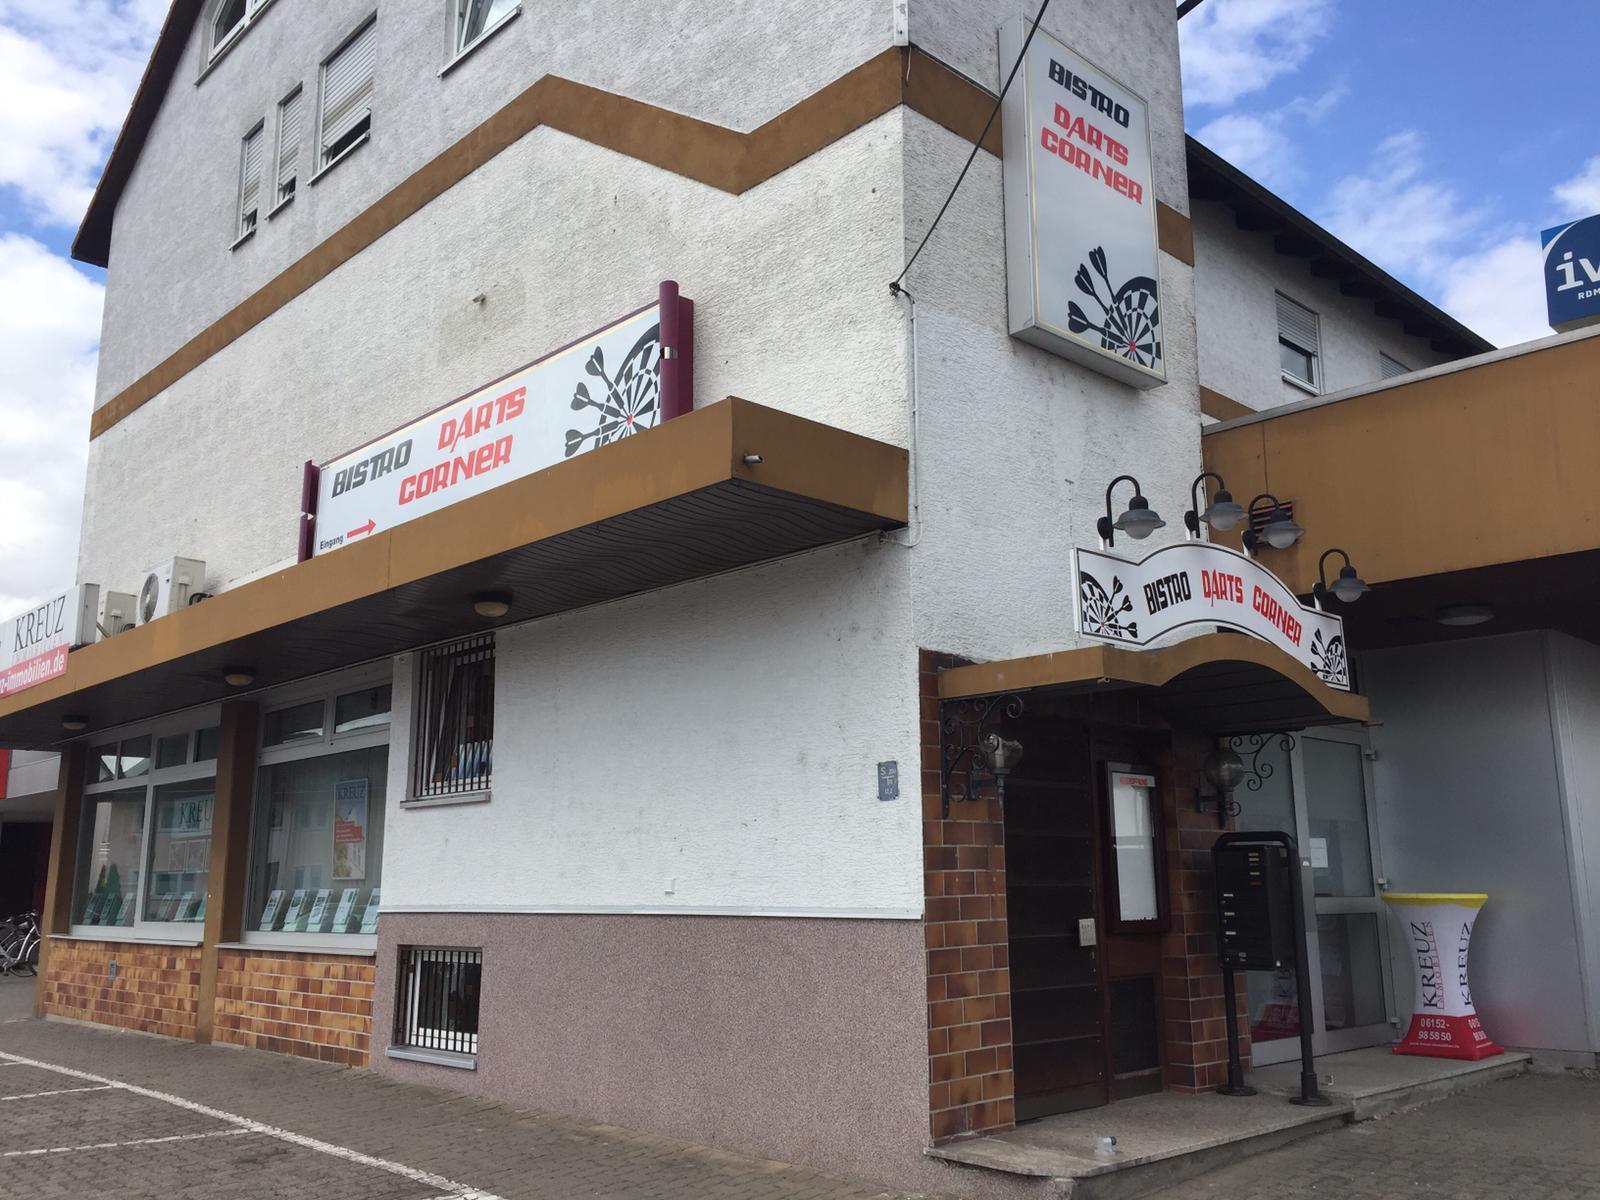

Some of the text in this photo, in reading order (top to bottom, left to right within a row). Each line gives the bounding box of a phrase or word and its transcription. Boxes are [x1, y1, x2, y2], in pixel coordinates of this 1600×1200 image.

[1049, 59, 1129, 127] BISTRO
[1041, 127, 1142, 205] CORNER
[1054, 104, 1129, 166] DARTS
[331, 386, 527, 498] BISTRO DARTS
[398, 434, 514, 506] CORNER
[320, 535, 344, 550] Eingang
[13, 594, 66, 653] KREUZ
[1143, 568, 1302, 646] BISTRO DARTS CORNER
[1410, 921, 1438, 1008] KREUZ
[1458, 922, 1472, 1006] KREUZ
